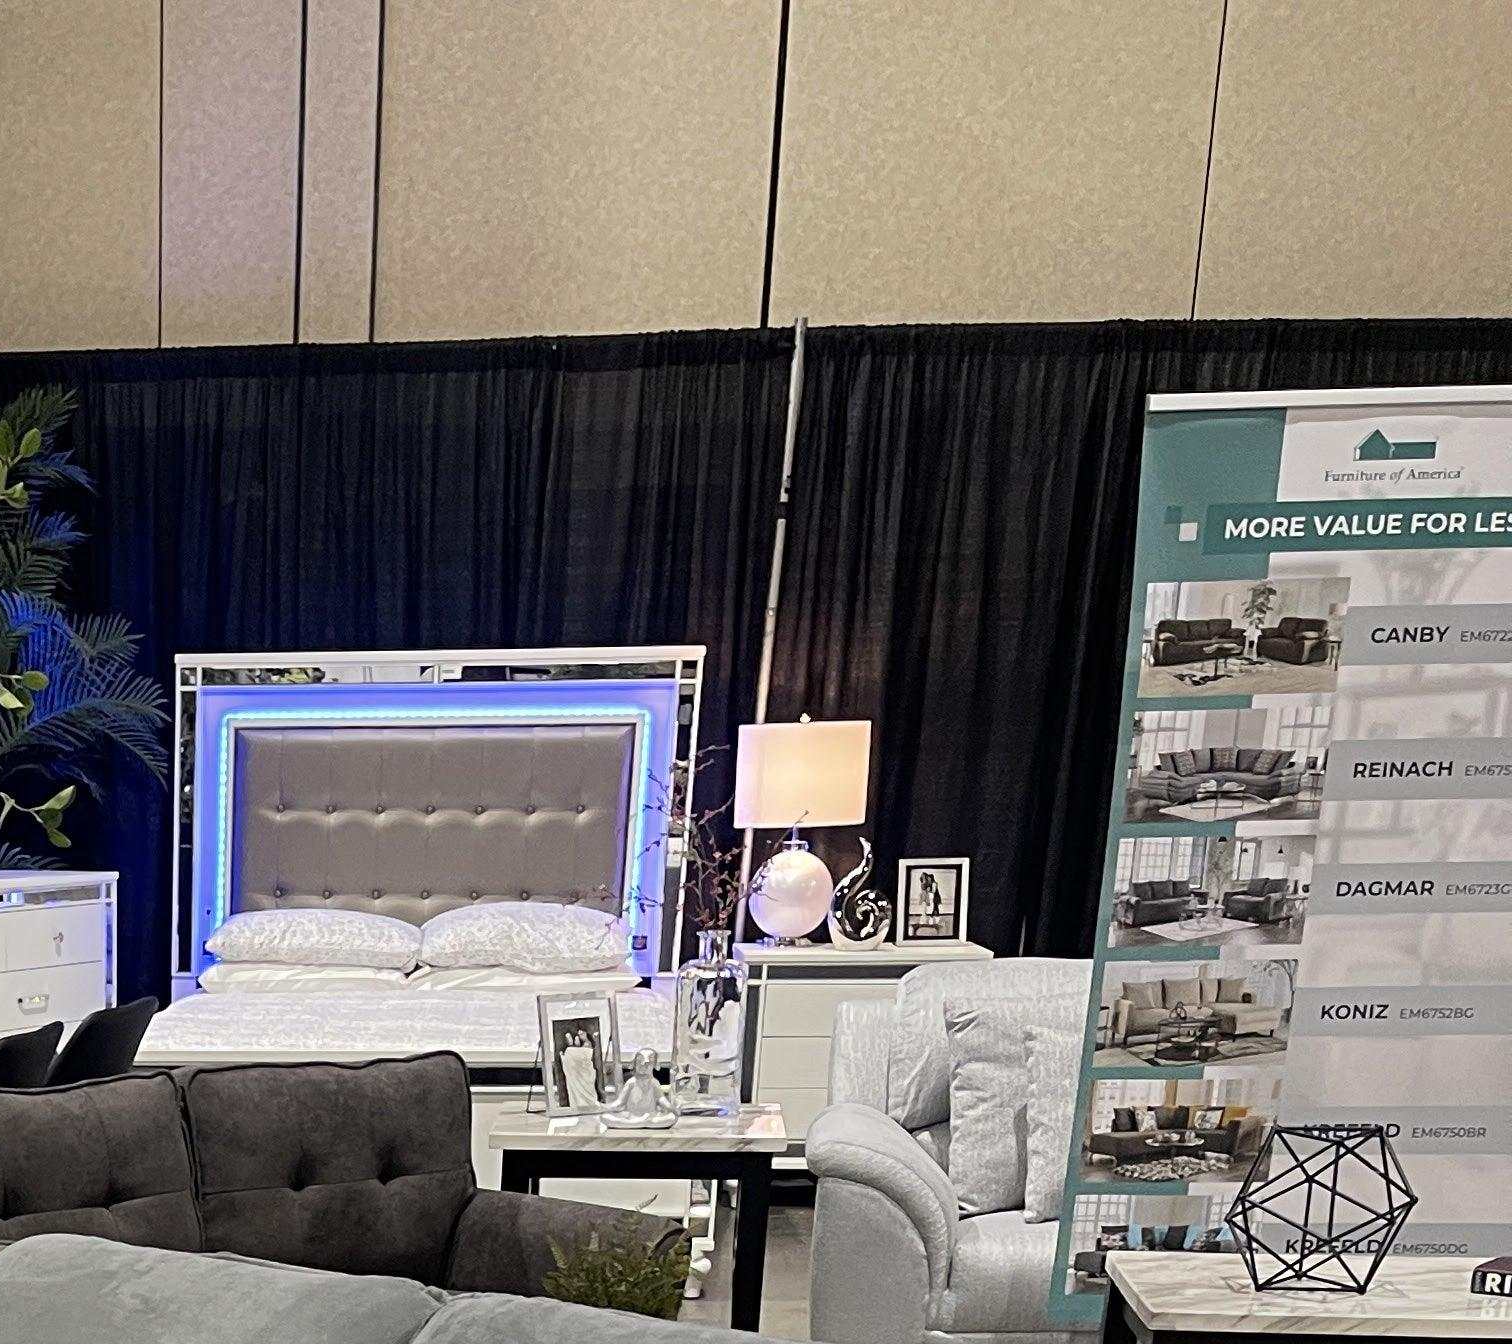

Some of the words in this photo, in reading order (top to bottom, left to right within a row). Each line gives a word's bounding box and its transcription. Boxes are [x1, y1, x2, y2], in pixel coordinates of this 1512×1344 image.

[1324, 469, 1386, 482] Furniture
[1390, 467, 1406, 484] of
[1224, 516, 1306, 539] MORE
[1313, 513, 1404, 536] VALUE
[1410, 512, 1467, 534] FOR
[1371, 626, 1450, 643] CANBY
[1353, 761, 1454, 778] REINACH
[1336, 880, 1435, 897] DAGMAR
[1320, 1004, 1390, 1020] KONIZ
[1285, 1239, 1382, 1254] KREFELD
